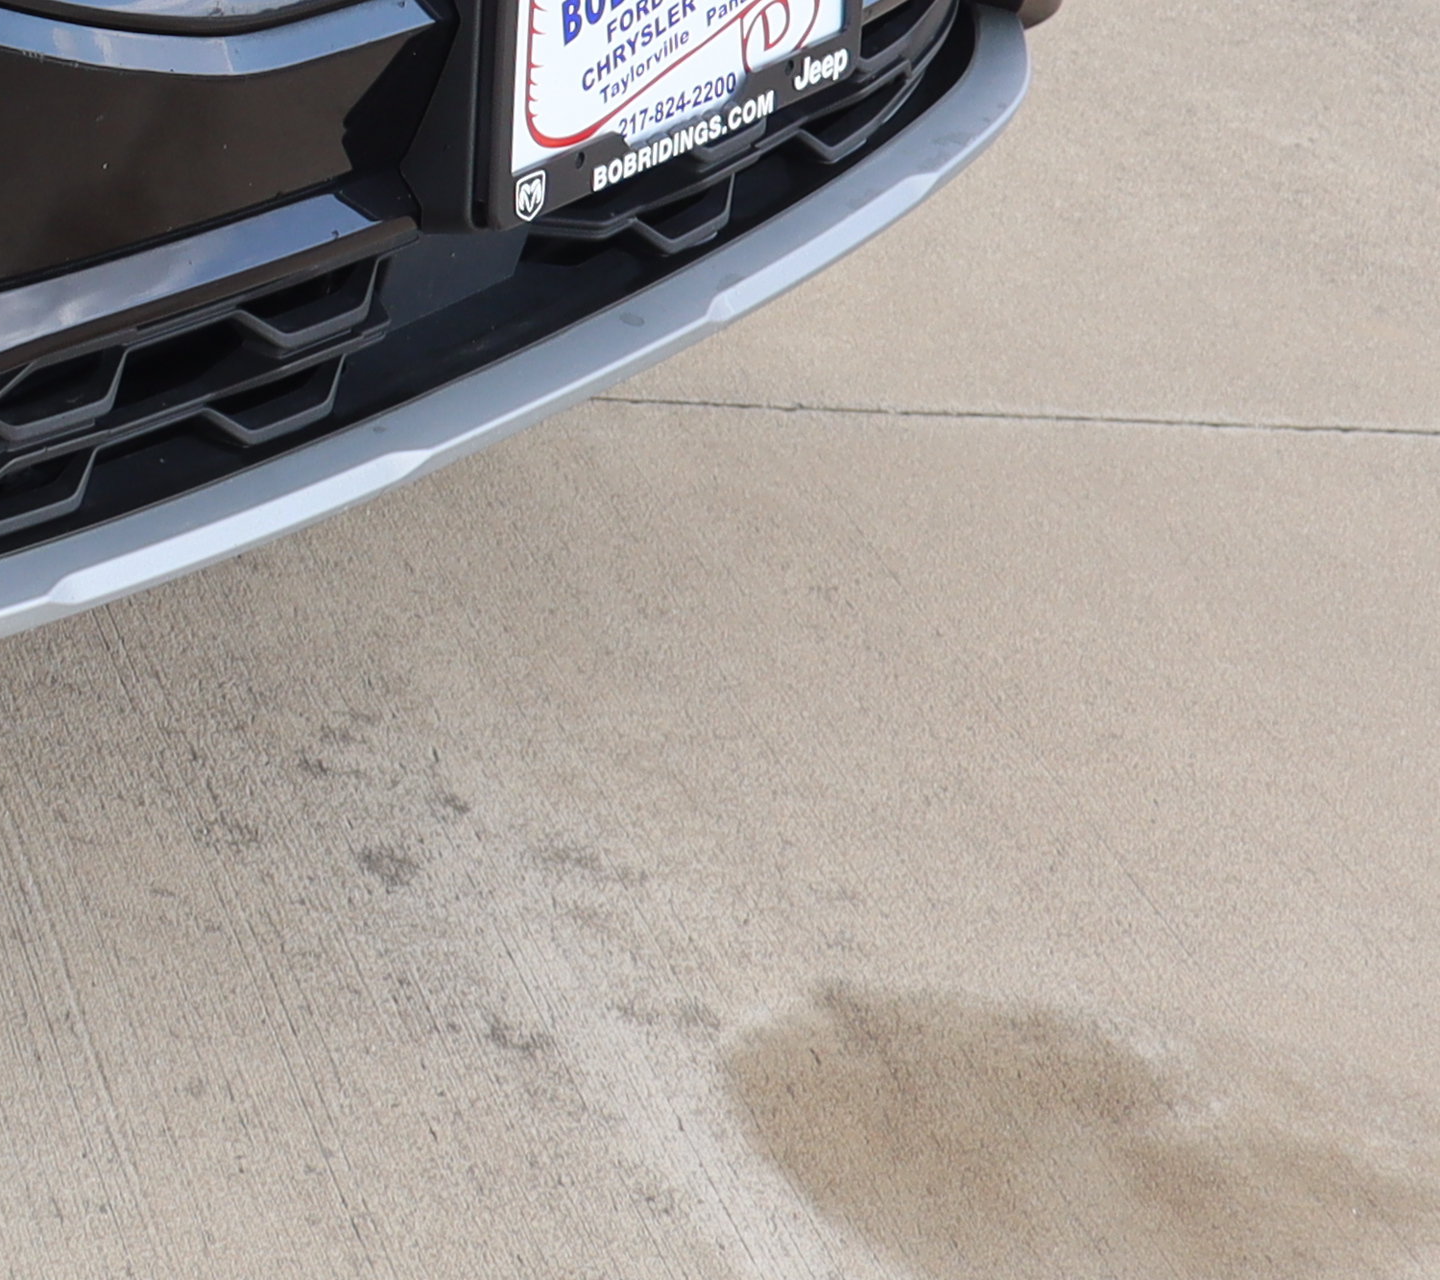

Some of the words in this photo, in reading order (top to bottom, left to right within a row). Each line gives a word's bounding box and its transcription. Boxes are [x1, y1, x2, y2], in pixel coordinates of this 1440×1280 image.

[599, 30, 690, 104] Taylorville
[794, 48, 849, 91] Jeep
[618, 71, 738, 139] 217-824-2200
[592, 90, 775, 192] BOBRIDINGS.COM
